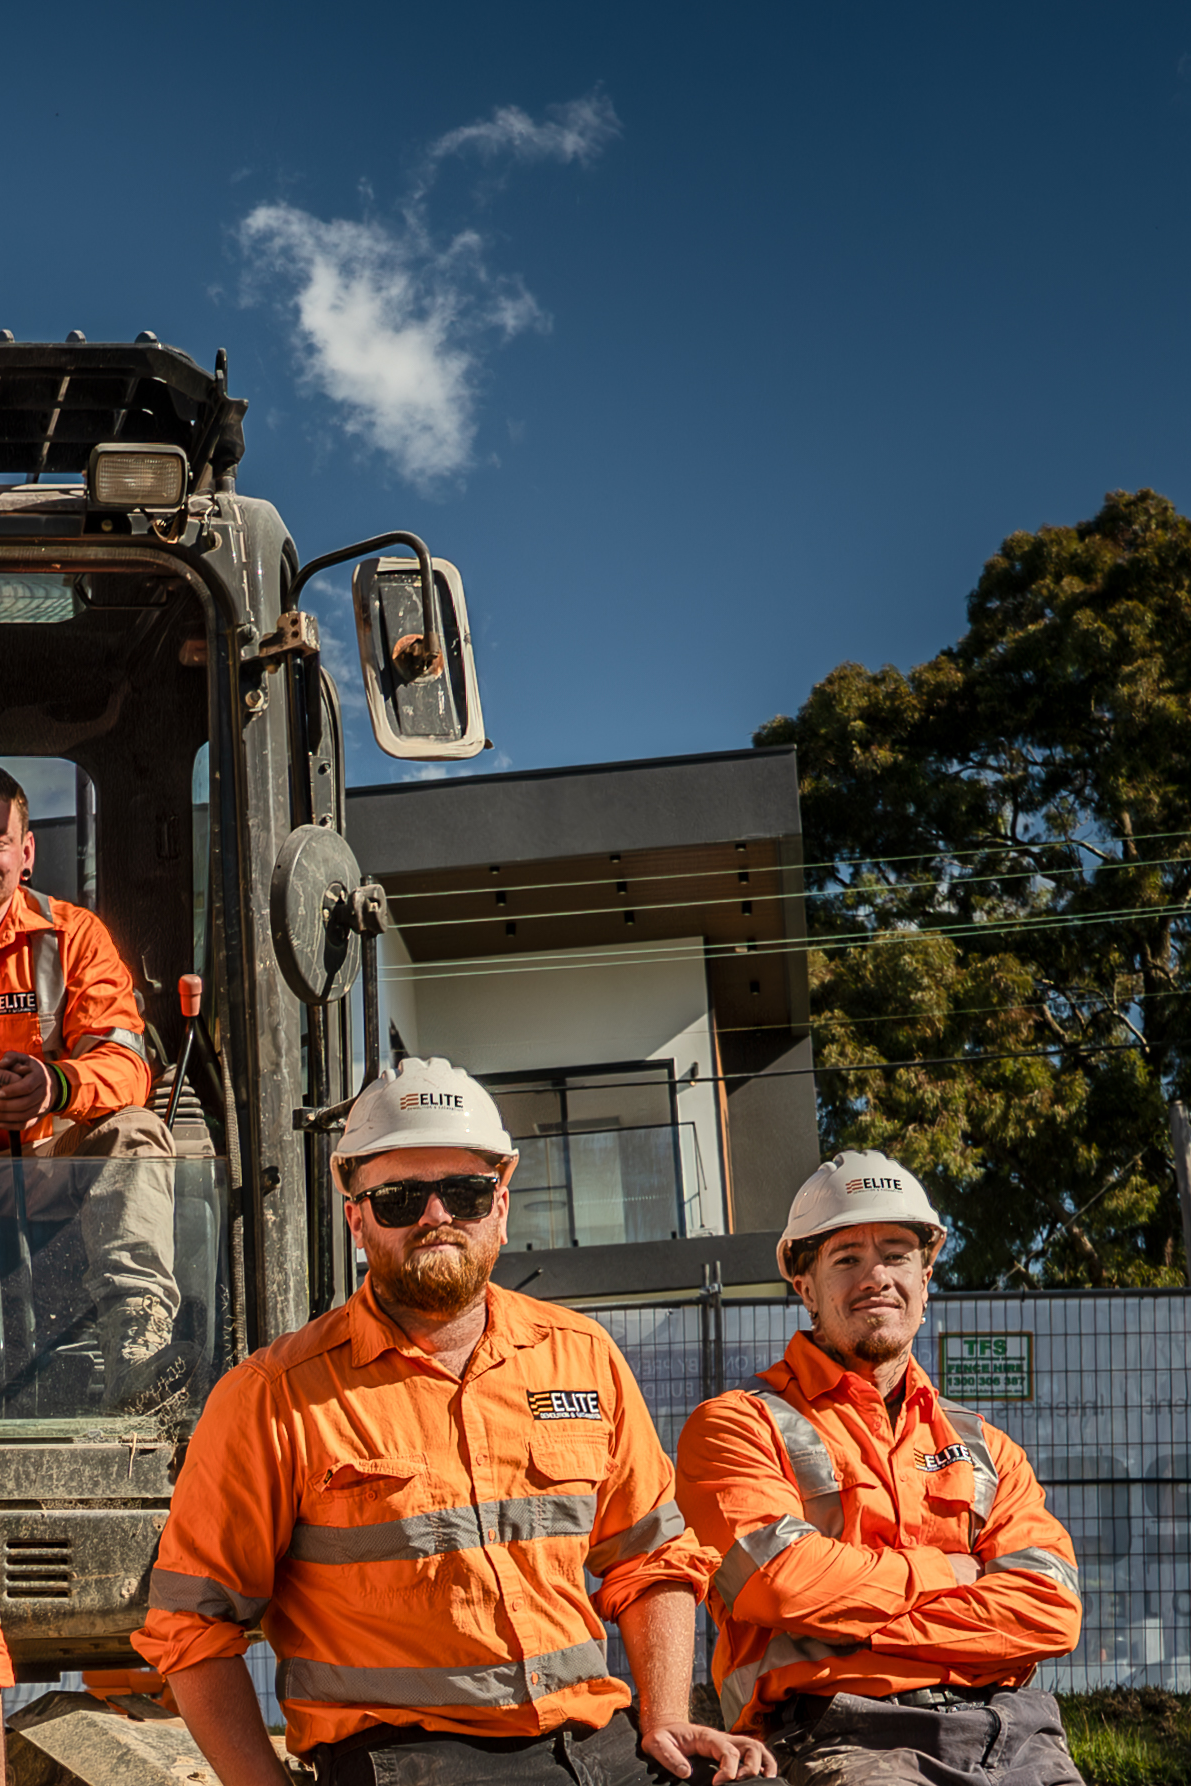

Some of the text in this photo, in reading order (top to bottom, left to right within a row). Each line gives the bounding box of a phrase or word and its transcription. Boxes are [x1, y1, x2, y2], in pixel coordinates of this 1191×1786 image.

[420, 1093, 464, 1108] ELITE
[863, 1178, 903, 1190] ELITE
[964, 1339, 1007, 1356] TFS
[948, 1363, 1024, 1373] FENCE HIRE
[948, 1376, 975, 1386] 1300
[551, 1392, 600, 1413] ELITE
[924, 1443, 972, 1468] ELITE
